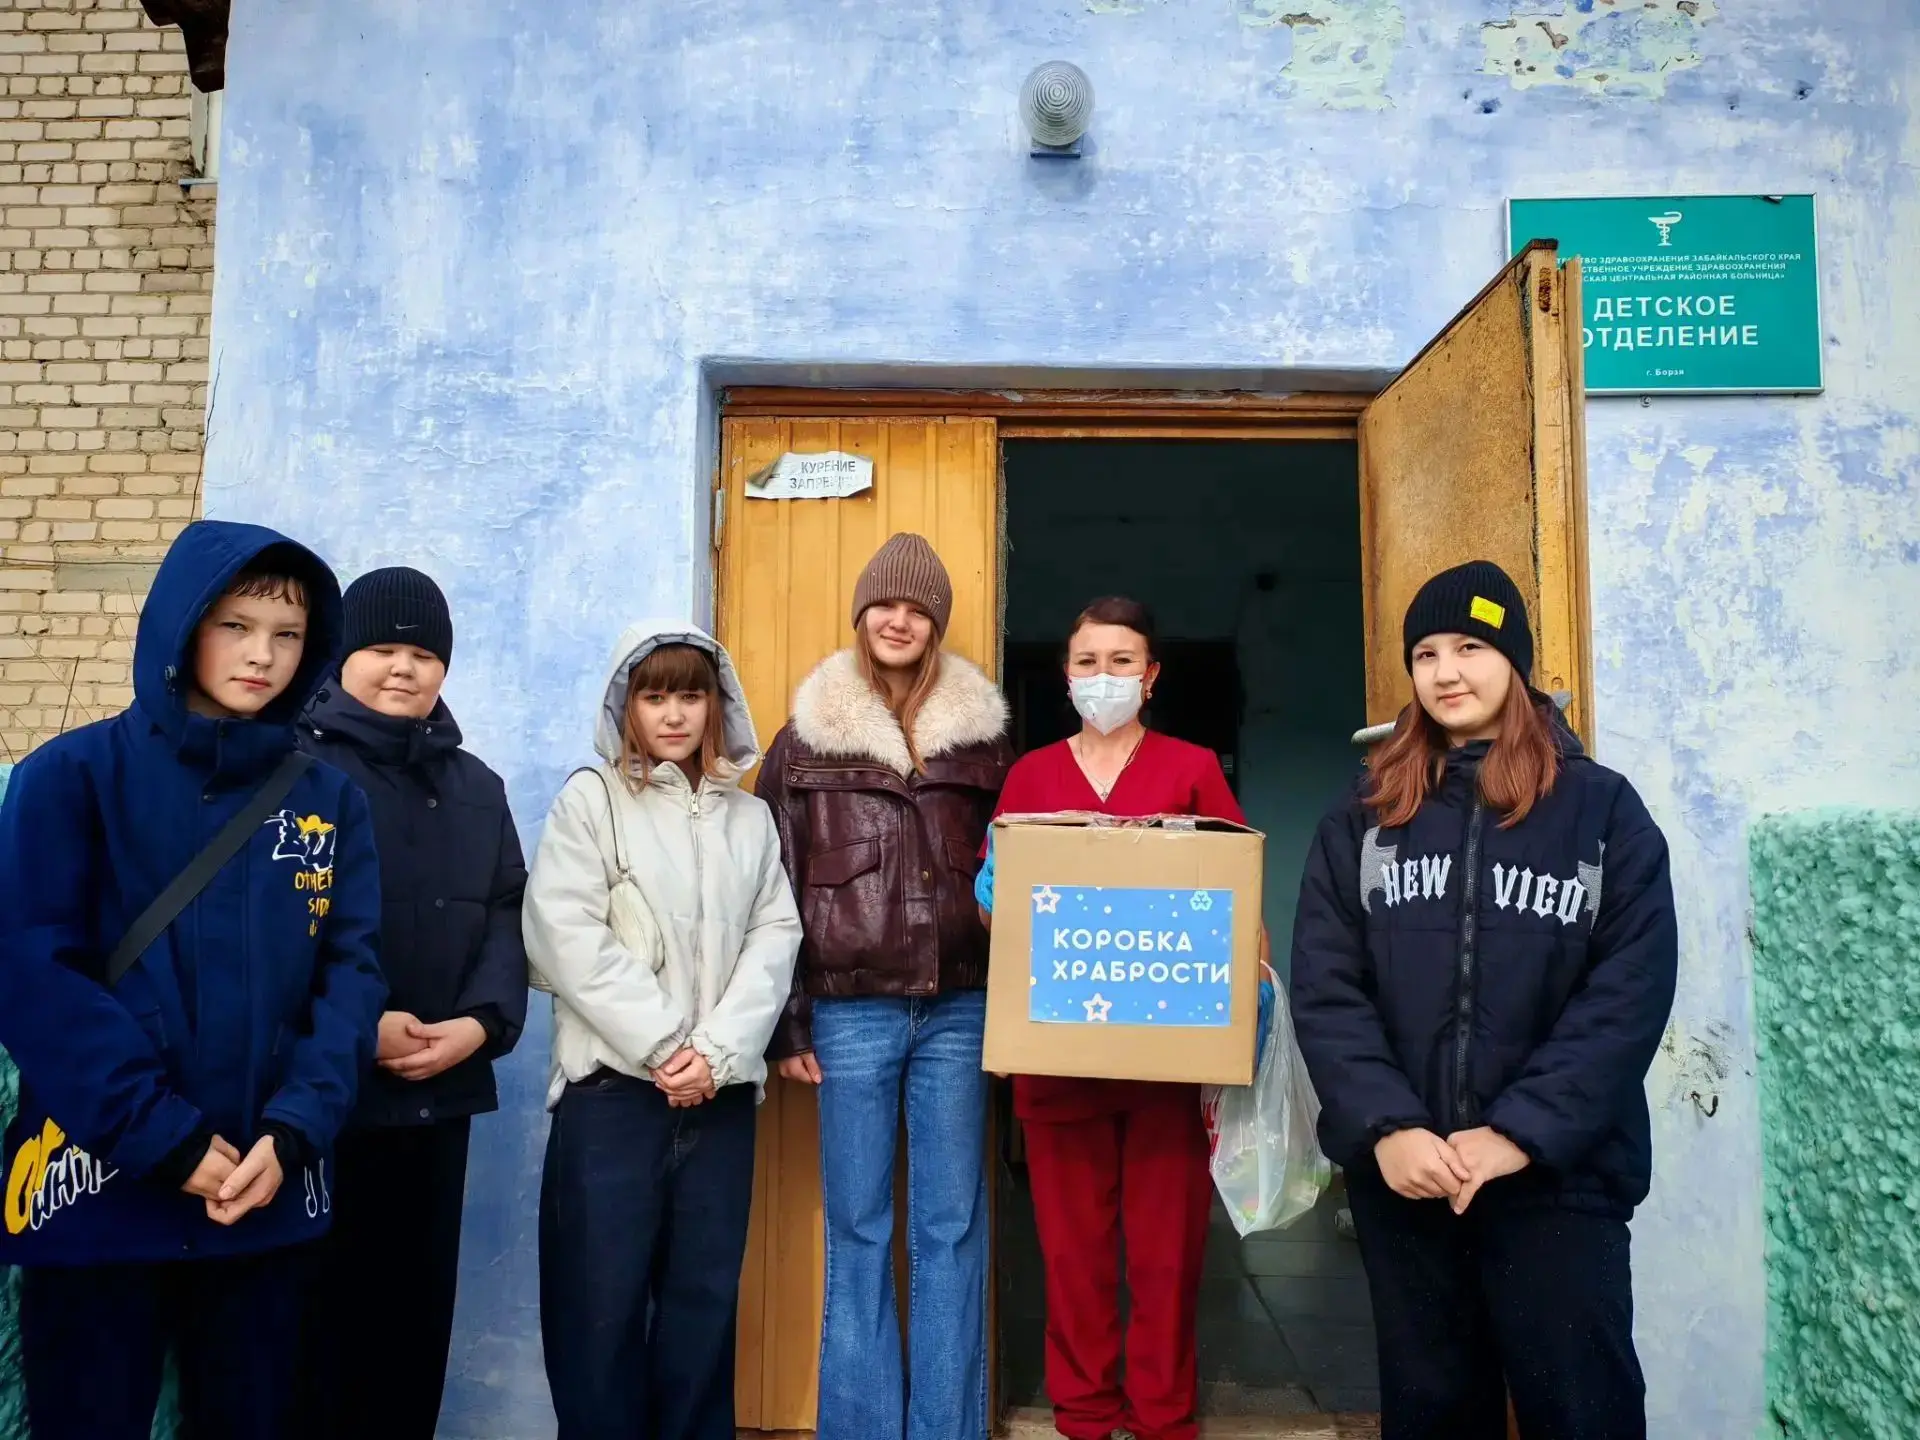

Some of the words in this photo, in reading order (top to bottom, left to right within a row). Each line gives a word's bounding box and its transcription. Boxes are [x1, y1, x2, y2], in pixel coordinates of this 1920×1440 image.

[1581, 265, 1630, 273] СТВЕННОЕ
[1632, 264, 1694, 273] УЧРЕЖДЕНИЕ
[1696, 262, 1786, 271] ЗДРАВООХРАНЕНИЯ
[1600, 255, 1690, 264] ЗДРАВООХРАНЕНИЯ
[1692, 253, 1776, 262] ЗАБАЙКАЛЬСКОГО
[1778, 253, 1801, 261] КРАЯ
[1610, 274, 1676, 283] ЦЕНТРАЛЬНАЯ
[1678, 272, 1728, 281] РАЙОННАЯ
[1593, 295, 1737, 322] ДЕТСКОЕ
[1582, 324, 1760, 352] ОТДЕЛЕНИЕ
[1655, 368, 1685, 377] Борзя
[801, 460, 856, 474] КУРЕНИЕ
[1491, 861, 1587, 926] VIGO
[307, 897, 331, 918] SID
[1053, 927, 1193, 952] КОРОБКА
[1051, 959, 1230, 985] ХРАБРОСТИ
